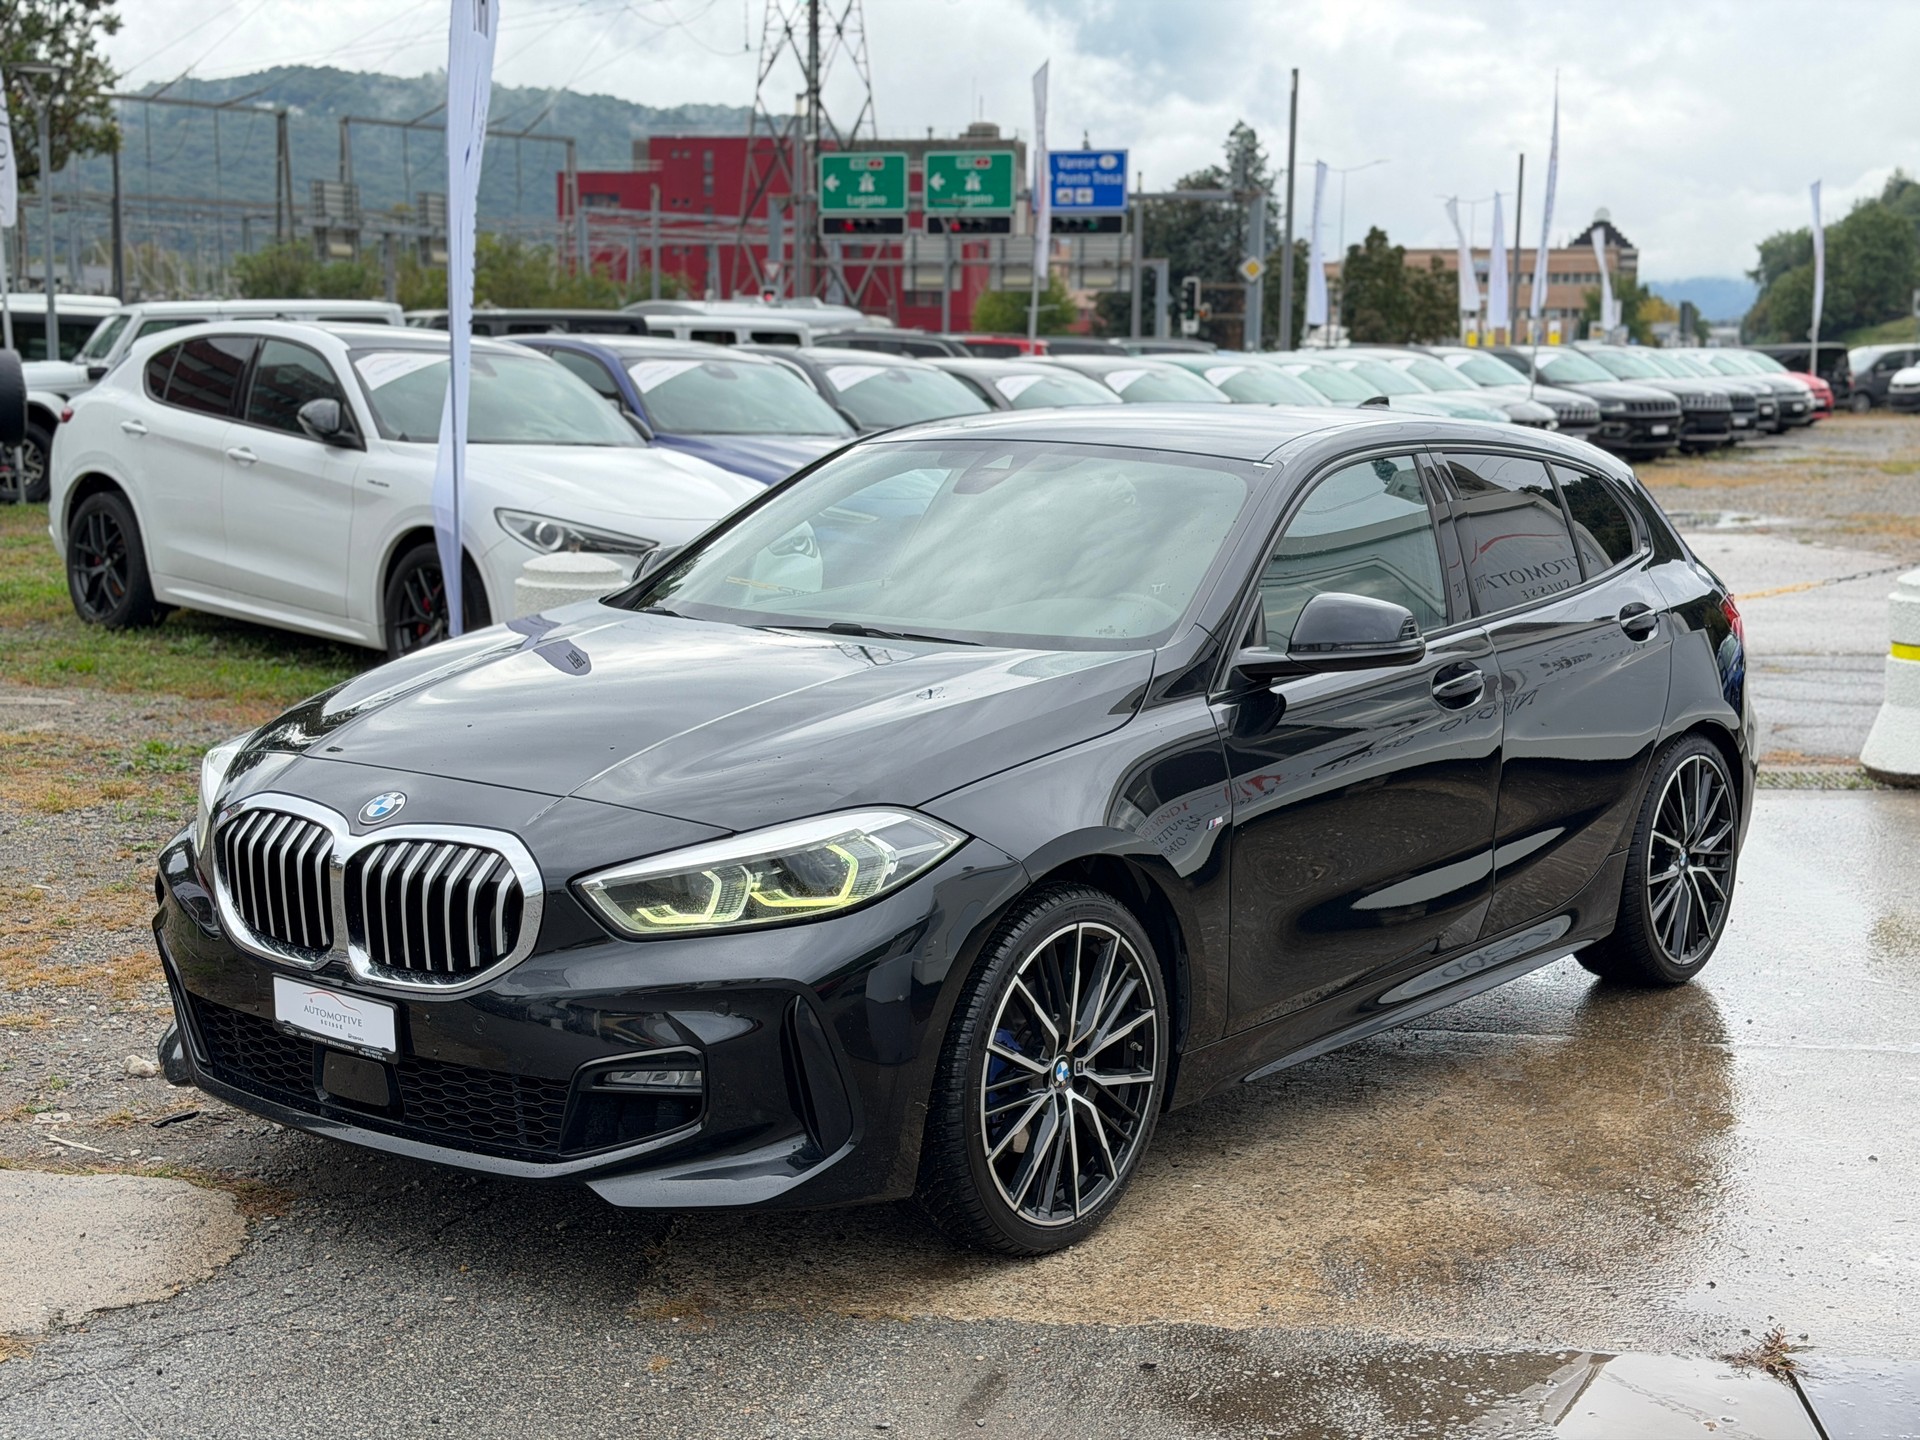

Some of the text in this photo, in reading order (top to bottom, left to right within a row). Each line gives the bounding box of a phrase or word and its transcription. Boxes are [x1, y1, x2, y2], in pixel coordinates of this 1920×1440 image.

[1056, 155, 1097, 170] Varese
[1056, 170, 1123, 185] Ponte Tresa
[846, 193, 888, 209] Lugano
[303, 1004, 363, 1028] AUTOMOTIVE
[320, 1019, 344, 1030] SUISSE
